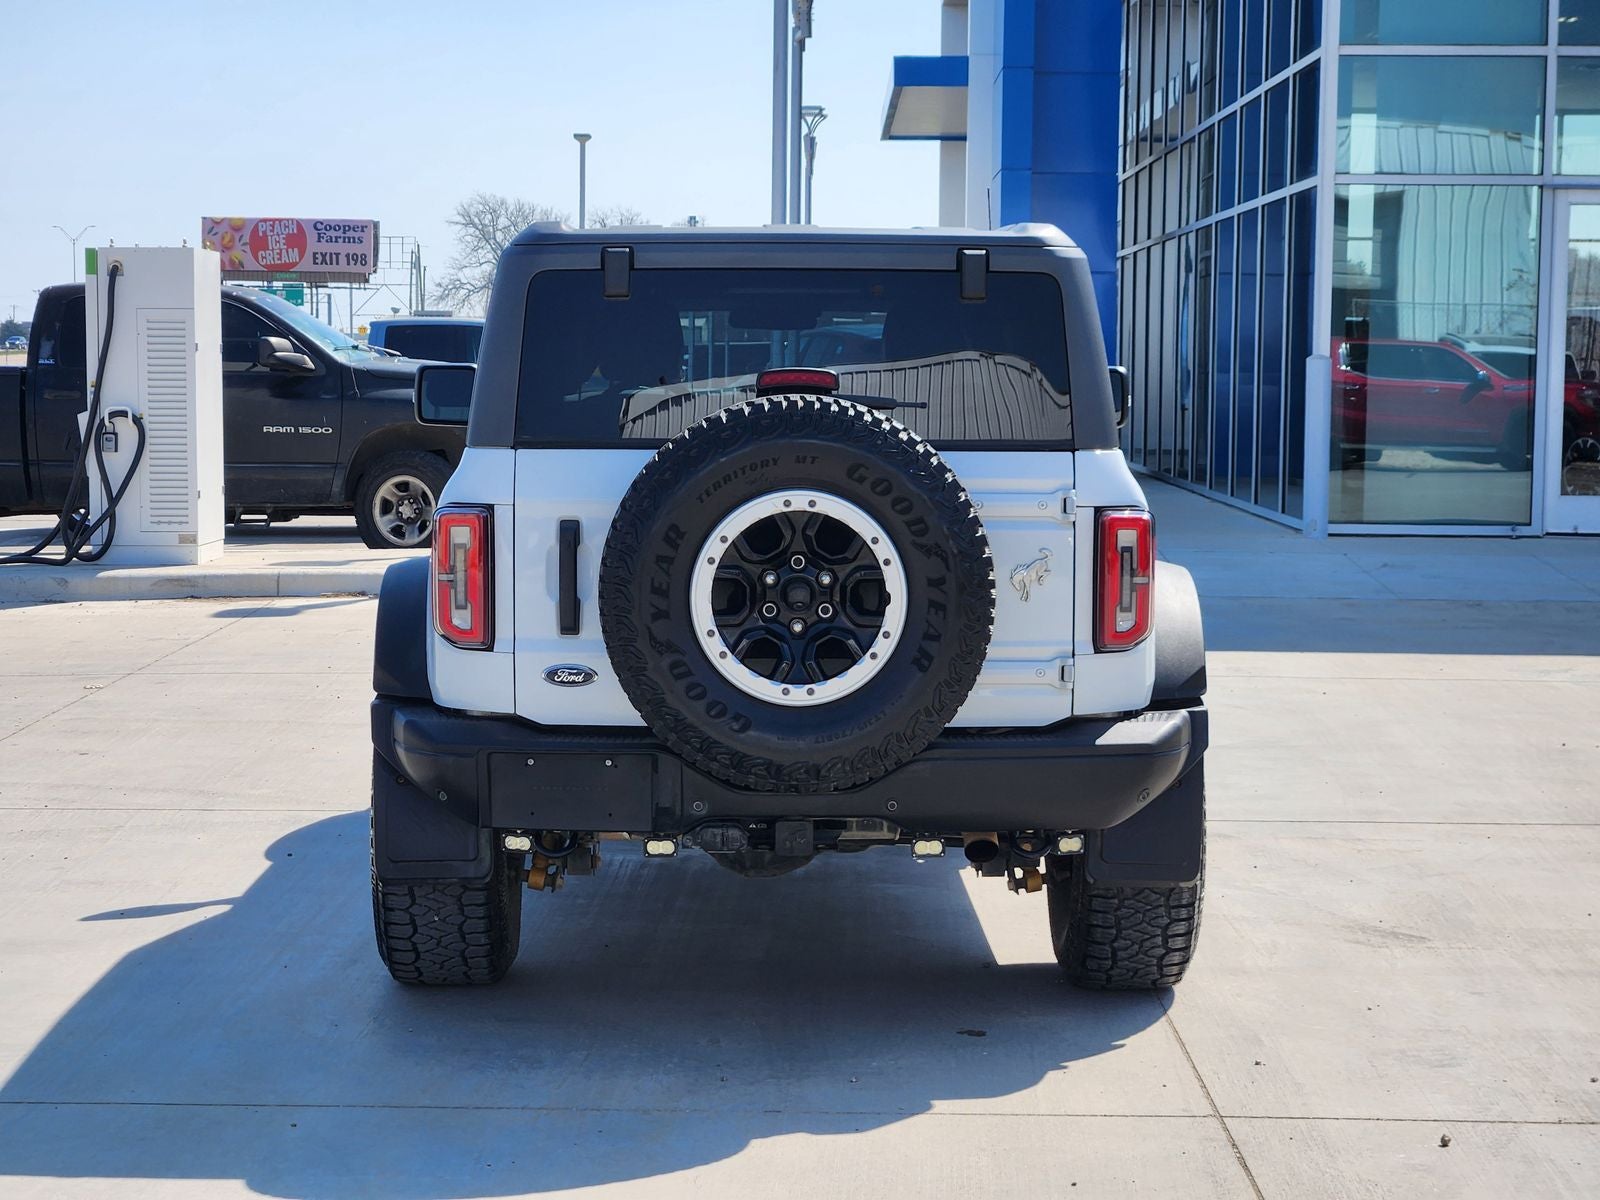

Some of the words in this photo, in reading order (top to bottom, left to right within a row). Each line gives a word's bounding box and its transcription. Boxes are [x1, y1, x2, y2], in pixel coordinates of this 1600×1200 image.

[257, 219, 297, 236] PEACH
[313, 221, 368, 235] Cooper
[267, 234, 287, 250] ICE
[315, 232, 364, 244] Farms
[257, 247, 299, 265] CREAM
[312, 251, 341, 266] EXIT
[345, 252, 368, 267] 198
[262, 425, 295, 433] RAM
[298, 426, 333, 434] 1500
[695, 455, 781, 504] TERRITORY
[794, 454, 820, 465] MT
[554, 668, 586, 682] Ford
